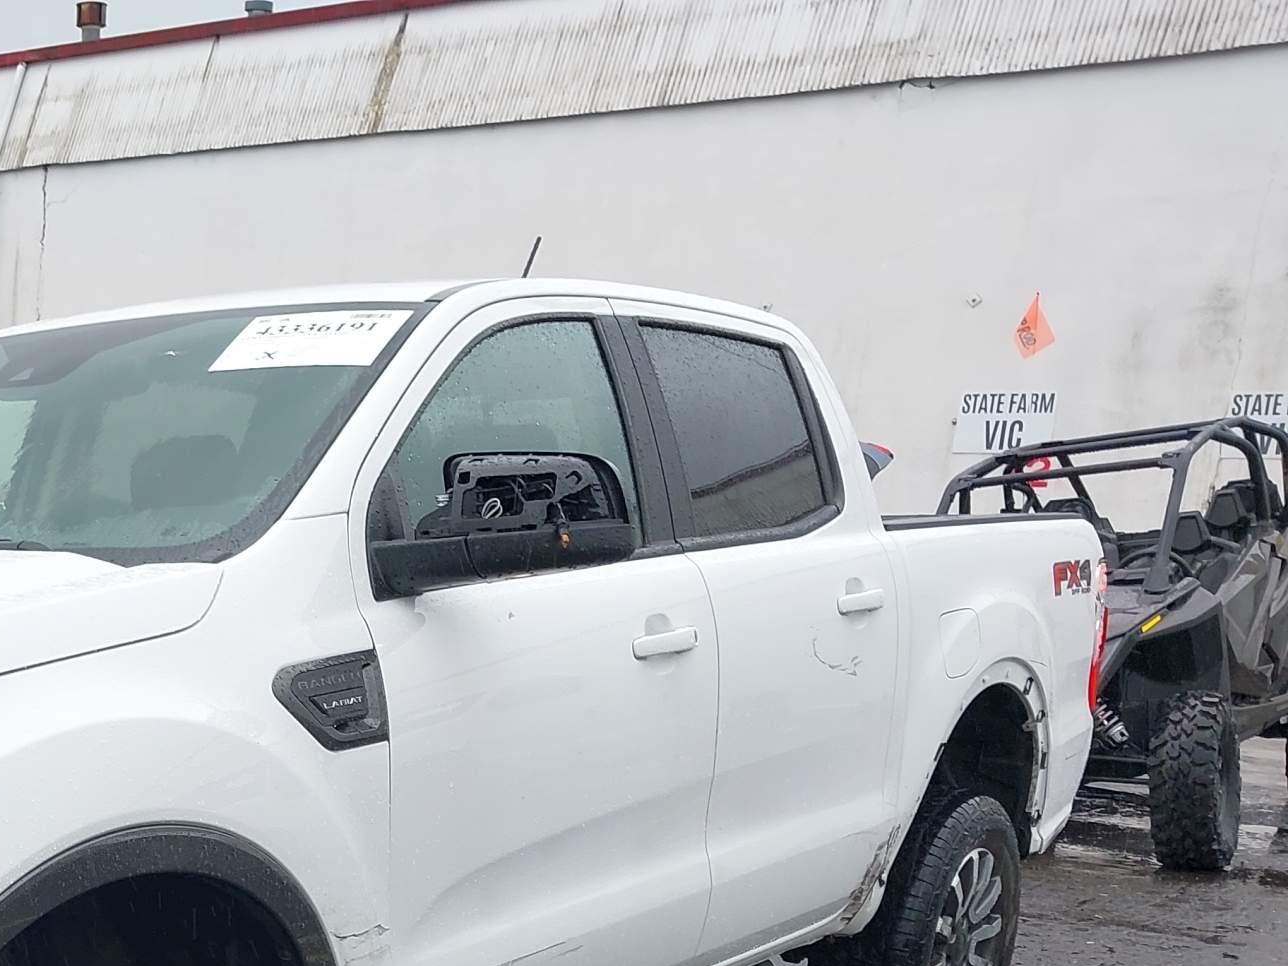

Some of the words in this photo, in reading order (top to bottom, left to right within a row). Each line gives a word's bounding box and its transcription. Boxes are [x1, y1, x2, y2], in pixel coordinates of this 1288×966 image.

[962, 393, 1007, 414] STATE
[1008, 393, 1056, 414] FARM
[1231, 393, 1284, 416] STATE
[984, 419, 1025, 450] VIC
[1052, 559, 1092, 597] FX4
